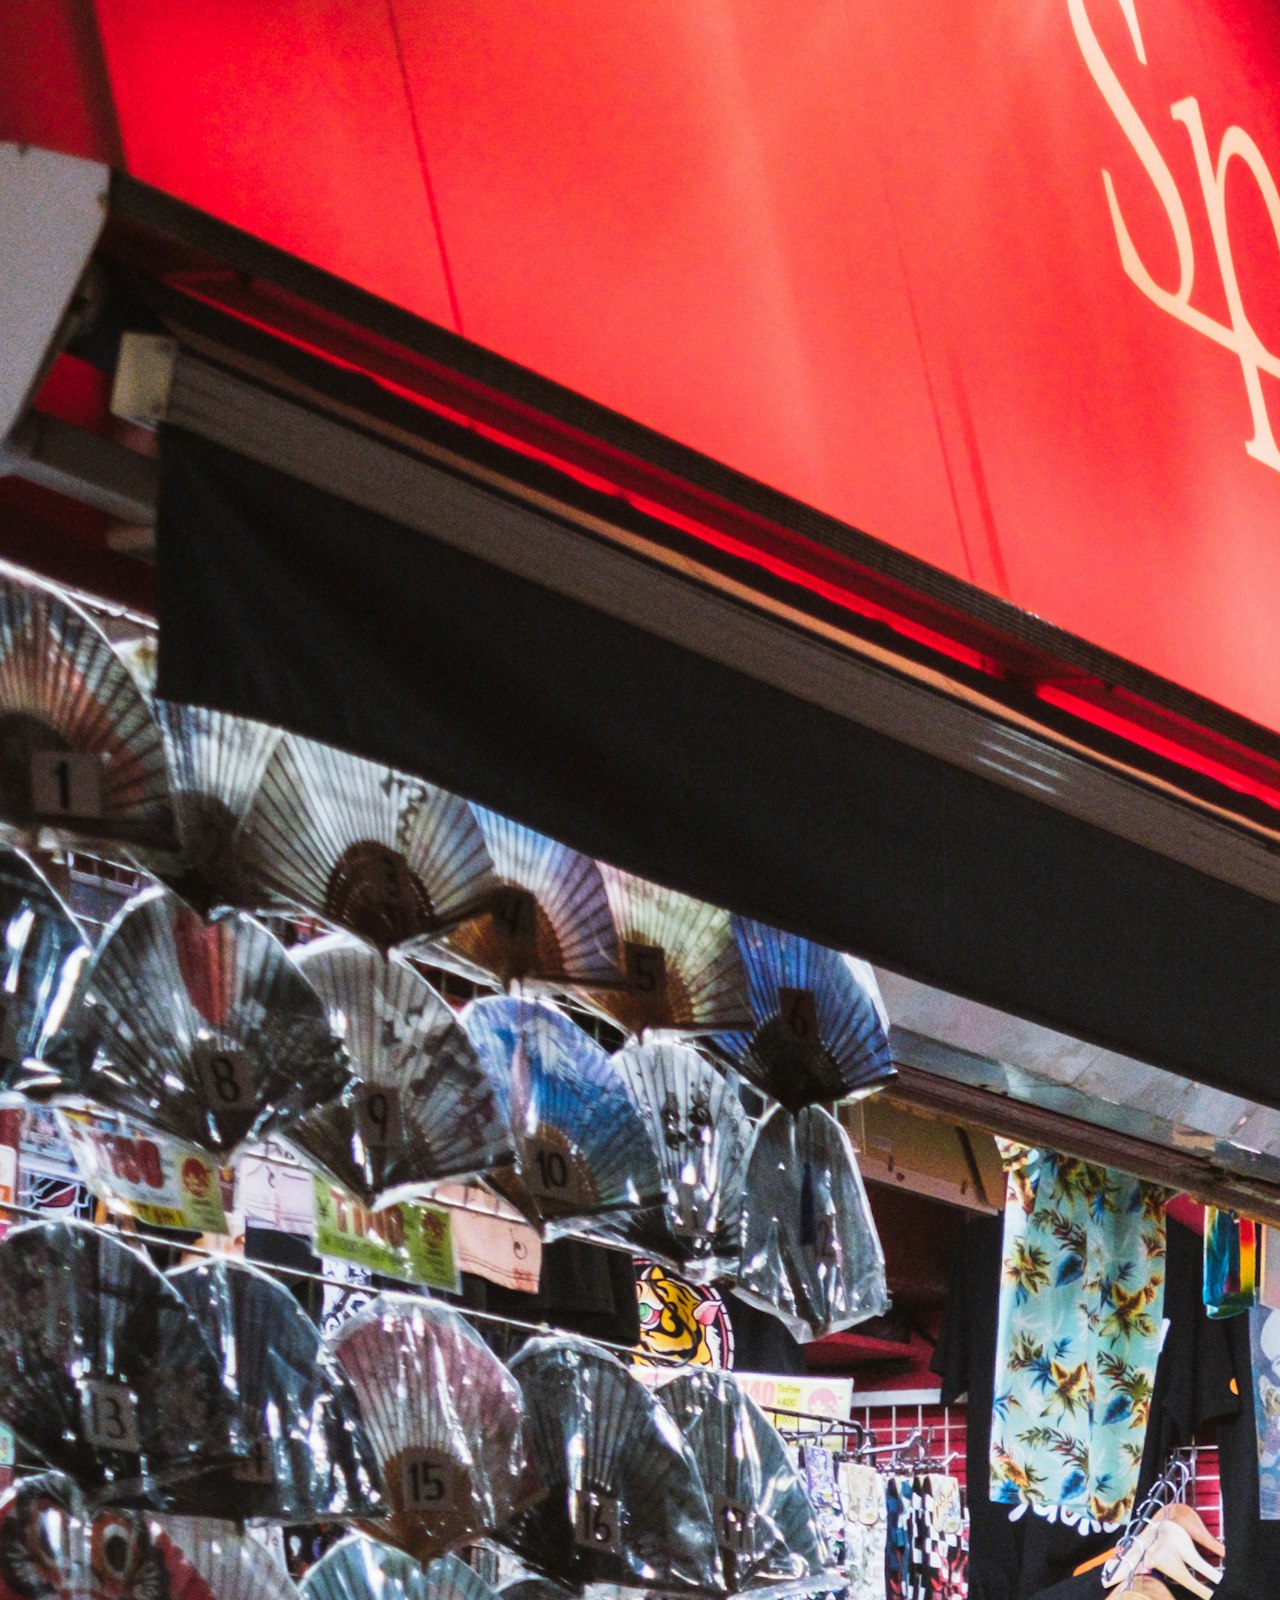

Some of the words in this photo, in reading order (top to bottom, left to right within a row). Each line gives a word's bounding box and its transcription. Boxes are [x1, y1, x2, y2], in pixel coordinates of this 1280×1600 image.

[533, 1150, 568, 1190] 10
[92, 1399, 124, 1444] 13
[409, 1461, 444, 1500] 15
